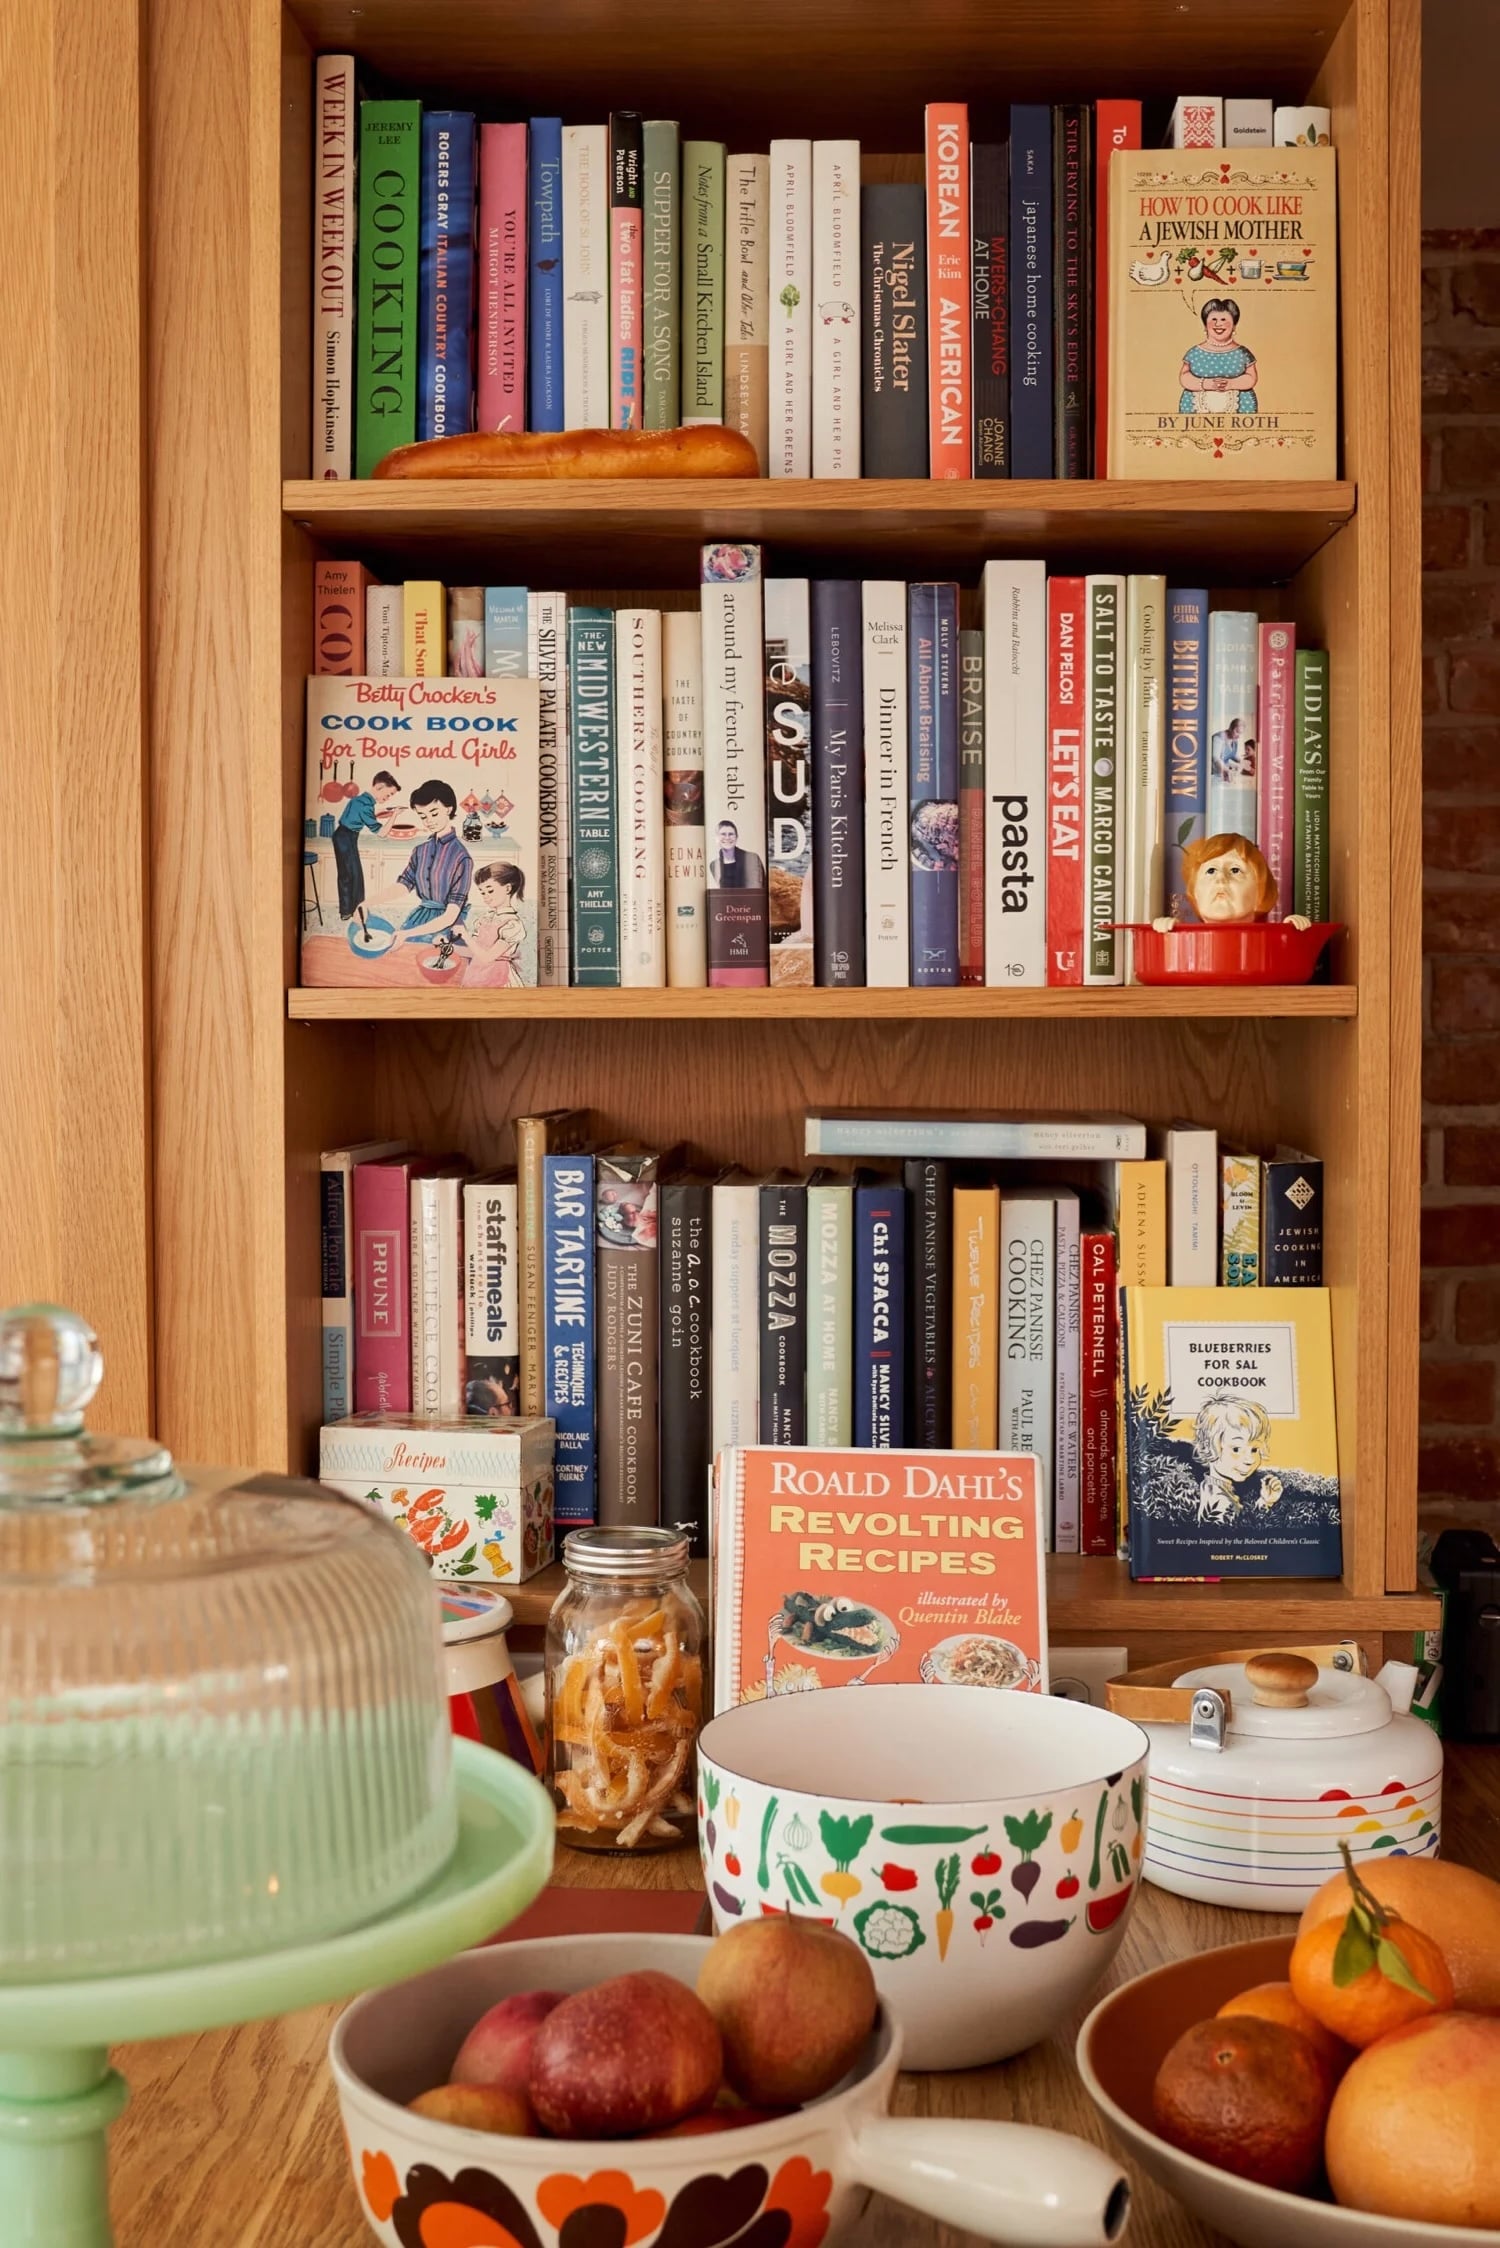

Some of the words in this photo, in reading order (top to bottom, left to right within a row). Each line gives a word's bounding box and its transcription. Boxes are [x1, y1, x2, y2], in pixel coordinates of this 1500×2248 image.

[322, 71, 347, 147] WEEK
[365, 121, 414, 132] JEREMY
[1232, 126, 1267, 135] Goldstein
[378, 134, 402, 145] LEE
[438, 132, 450, 187] ROGERS
[322, 153, 346, 178] IN
[616, 149, 626, 194] Paterson
[626, 149, 638, 184] Wright
[698, 164, 714, 200] Notes
[937, 123, 961, 238] KOREAN
[437, 193, 450, 229] GRAY
[534, 157, 562, 244] Towpath
[653, 172, 671, 257] SUPPER
[693, 201, 714, 227] from
[1138, 196, 1184, 216] HOW
[1185, 196, 1209, 215] TO
[1212, 196, 1263, 216] COOK
[1266, 196, 1304, 215] LIKE
[321, 187, 346, 262] WEEK
[504, 211, 517, 274] YOU'RE
[697, 231, 709, 240] a
[1022, 200, 1040, 269] japanese
[1138, 221, 1153, 241] A
[1151, 220, 1219, 248] JEWISH
[1223, 219, 1305, 241] MOTHER
[436, 234, 449, 288] ITALIAN
[489, 227, 499, 286] MARGOT
[697, 243, 714, 290] Small
[872, 242, 885, 264] The
[938, 255, 961, 266] Eric
[975, 239, 989, 259] AT
[320, 264, 344, 318] OUT
[370, 170, 406, 418] COOKING
[503, 281, 516, 312] ALL
[653, 261, 671, 303] FOR
[872, 266, 884, 327] Christmas
[885, 241, 917, 308] Nigel
[938, 268, 962, 280] Kim
[975, 265, 989, 320] HOME
[1026, 275, 1041, 318] home
[435, 294, 448, 359] COUNTRY
[653, 307, 670, 322] A
[696, 292, 714, 355] Kitchen
[990, 236, 1007, 376] MYERS+CHANG
[326, 331, 341, 375] Simon
[488, 291, 499, 377] HENDERSON
[503, 320, 516, 394] INVITED
[653, 326, 671, 382] SONG
[893, 313, 917, 393] Slater
[1022, 323, 1042, 386] cooking
[696, 361, 713, 407] Island
[872, 331, 886, 393] Chronicles
[939, 297, 964, 445] AMERICAN
[320, 380, 340, 453] Hopkinson
[1158, 417, 1181, 430] BY
[1184, 416, 1228, 431] JUNE
[1230, 416, 1280, 430] ROTH
[318, 585, 356, 596] Thielen
[325, 571, 348, 582] Amy
[542, 606, 552, 625] THE
[723, 593, 743, 659] around
[867, 621, 904, 632] Melissa
[1060, 613, 1074, 648] DAN
[1096, 594, 1115, 642] SALT
[538, 628, 556, 682] SILVER
[577, 642, 607, 652] NEW
[830, 627, 841, 683] LEBOVITZ
[871, 634, 899, 647] Clark
[1095, 651, 1114, 676] TO
[345, 682, 407, 711] Betty
[408, 681, 497, 705] Crocker's
[720, 666, 737, 693] my
[1059, 654, 1075, 704] PELOSI
[1172, 641, 1200, 711] BITTER
[320, 715, 414, 730] COOK
[426, 716, 521, 732] BOOK
[538, 689, 556, 749] PALATE
[725, 701, 745, 758] french
[879, 688, 898, 763] Dinner
[962, 656, 983, 765] BRAISE
[1095, 687, 1114, 748] TASTE
[1303, 668, 1323, 765] LIDIA'S
[320, 738, 356, 770] for
[356, 737, 411, 767] Boys
[415, 740, 457, 760] and
[461, 738, 518, 767] Girls
[577, 658, 610, 820] MIDWESTERN
[824, 728, 848, 758] My
[1170, 719, 1198, 799] HONEY
[829, 764, 849, 808] Paris
[880, 770, 898, 789] in
[1052, 729, 1080, 799] LET'S
[539, 753, 558, 848] COOKBOOK
[726, 765, 745, 811] table
[580, 829, 610, 838] TABLE
[880, 797, 900, 871] French
[1052, 805, 1079, 861] EAT
[1094, 786, 1113, 854] MARCO
[830, 816, 850, 889] Kitchen
[993, 796, 1035, 913] pasta
[579, 900, 614, 909] THIELEN
[586, 890, 605, 899] AMY
[715, 913, 762, 923] Greenspan
[726, 904, 752, 914] Dorie
[1093, 865, 1113, 942] CANORA
[554, 1169, 585, 1218] BAR
[778, 1200, 786, 1217] THE
[925, 1164, 937, 1206] CHEZ
[670, 1218, 682, 1293] suzanne
[689, 1217, 702, 1249] the
[873, 1221, 890, 1257] Chi
[924, 1211, 937, 1273] PANISSE
[373, 1242, 390, 1325] PRUNE
[486, 1199, 507, 1343] staffmeals
[554, 1225, 586, 1328] TARTINE
[627, 1263, 638, 1291] THE
[767, 1225, 797, 1331] MOZZA
[1029, 1240, 1044, 1287] CHEZ
[1093, 1244, 1105, 1276] CAL
[873, 1261, 890, 1344] SPACCA
[924, 1276, 937, 1364] VEGETABLES
[1007, 1240, 1027, 1361] COOKING
[627, 1295, 643, 1354] ZUNI
[669, 1303, 684, 1348] goin
[1029, 1293, 1043, 1362] PANISSE
[1092, 1283, 1105, 1379] PETERNELL
[1188, 1342, 1272, 1353] BLUEBERRIES
[553, 1345, 569, 1358] &
[570, 1342, 585, 1407] TECHNIQUES
[689, 1312, 702, 1400] cookbook
[778, 1335, 786, 1386] COOKBOOK
[1204, 1359, 1230, 1370] FOR
[1235, 1359, 1258, 1370] SAL
[554, 1360, 568, 1404] RECIPES
[1196, 1376, 1267, 1388] COOKBOOK
[383, 1441, 449, 1474] Recipes
[626, 1426, 637, 1505] COOKBOOK
[770, 1461, 891, 1498] ROALD
[903, 1464, 1024, 1501] DAHL'S
[769, 1504, 1026, 1540] REVOLTING
[798, 1541, 998, 1580] RECIPES
[1211, 1554, 1234, 1562] ROBERT
[1236, 1554, 1269, 1562] McCLOSKEY
[898, 1606, 970, 1628] Quentin
[975, 1608, 1024, 1627] Blake
[917, 1591, 989, 1608] illustrated
[991, 1594, 1010, 1612] by
